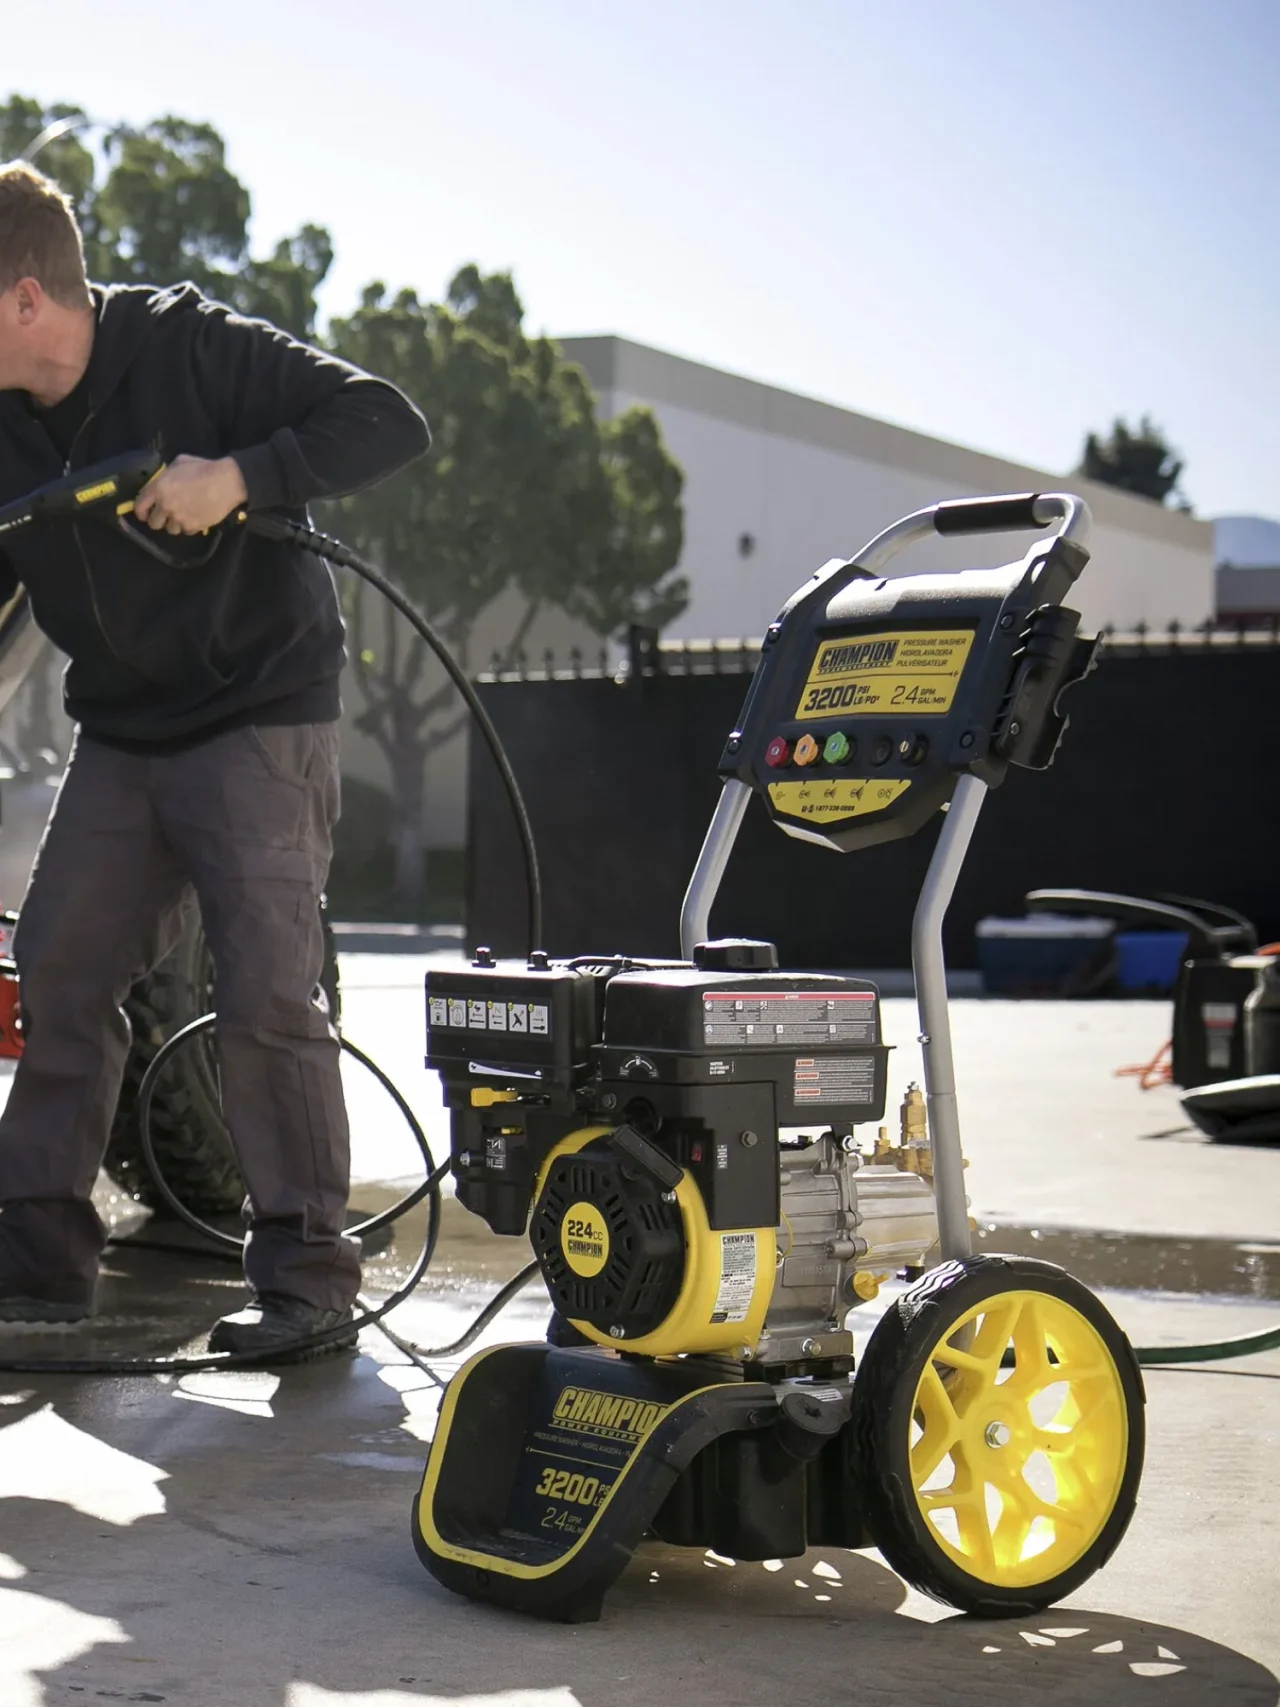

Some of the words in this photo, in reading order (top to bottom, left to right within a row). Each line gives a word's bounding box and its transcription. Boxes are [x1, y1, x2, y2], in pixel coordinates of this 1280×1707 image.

[904, 638, 937, 646] PRESSURE
[938, 637, 967, 645] WASHER
[820, 640, 900, 669] CHAMPION
[804, 684, 857, 711] 3200
[857, 685, 871, 694] PSI
[890, 685, 920, 705] 2.4
[920, 688, 936, 696] GPM
[568, 1239, 603, 1257] CHAMPION
[722, 1233, 755, 1245] CHAMPION
[552, 1419, 589, 1431] POWER
[535, 1467, 600, 1505] 3200
[598, 1484, 612, 1496] PS
[540, 1506, 569, 1530] 2.4
